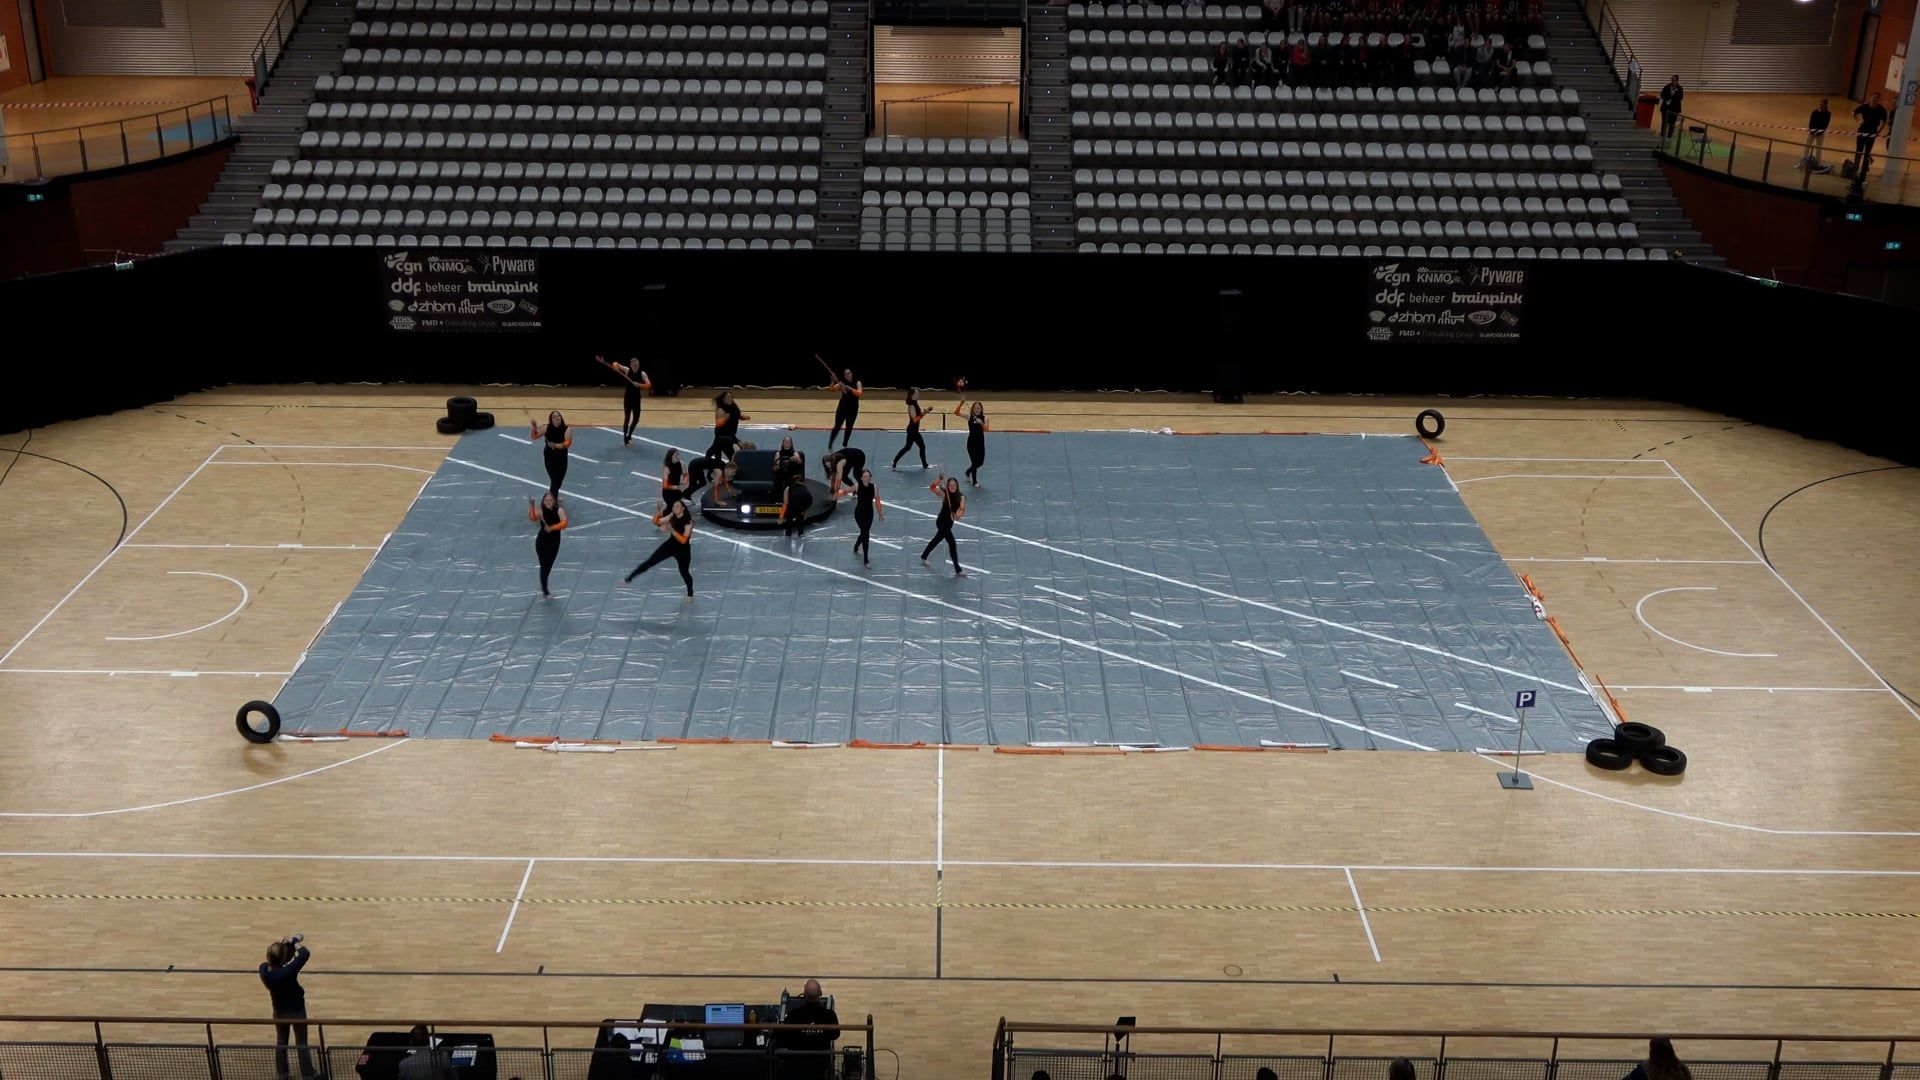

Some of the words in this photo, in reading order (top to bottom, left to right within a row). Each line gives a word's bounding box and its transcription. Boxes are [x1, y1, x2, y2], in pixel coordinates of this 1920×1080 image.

[396, 261, 423, 275] cgn
[429, 262, 464, 273] KNMO
[492, 256, 535, 274] Pyware
[1384, 271, 1411, 286] cgn
[1416, 273, 1452, 284] KNMO
[1481, 267, 1524, 285] Pyware
[391, 277, 422, 296] ddf
[425, 282, 462, 293] beheer
[467, 281, 539, 295] brainpink
[1375, 288, 1405, 307] ddf
[1409, 292, 1446, 303] beheer
[1452, 291, 1523, 306] brainpink
[1519, 692, 1532, 707] P
